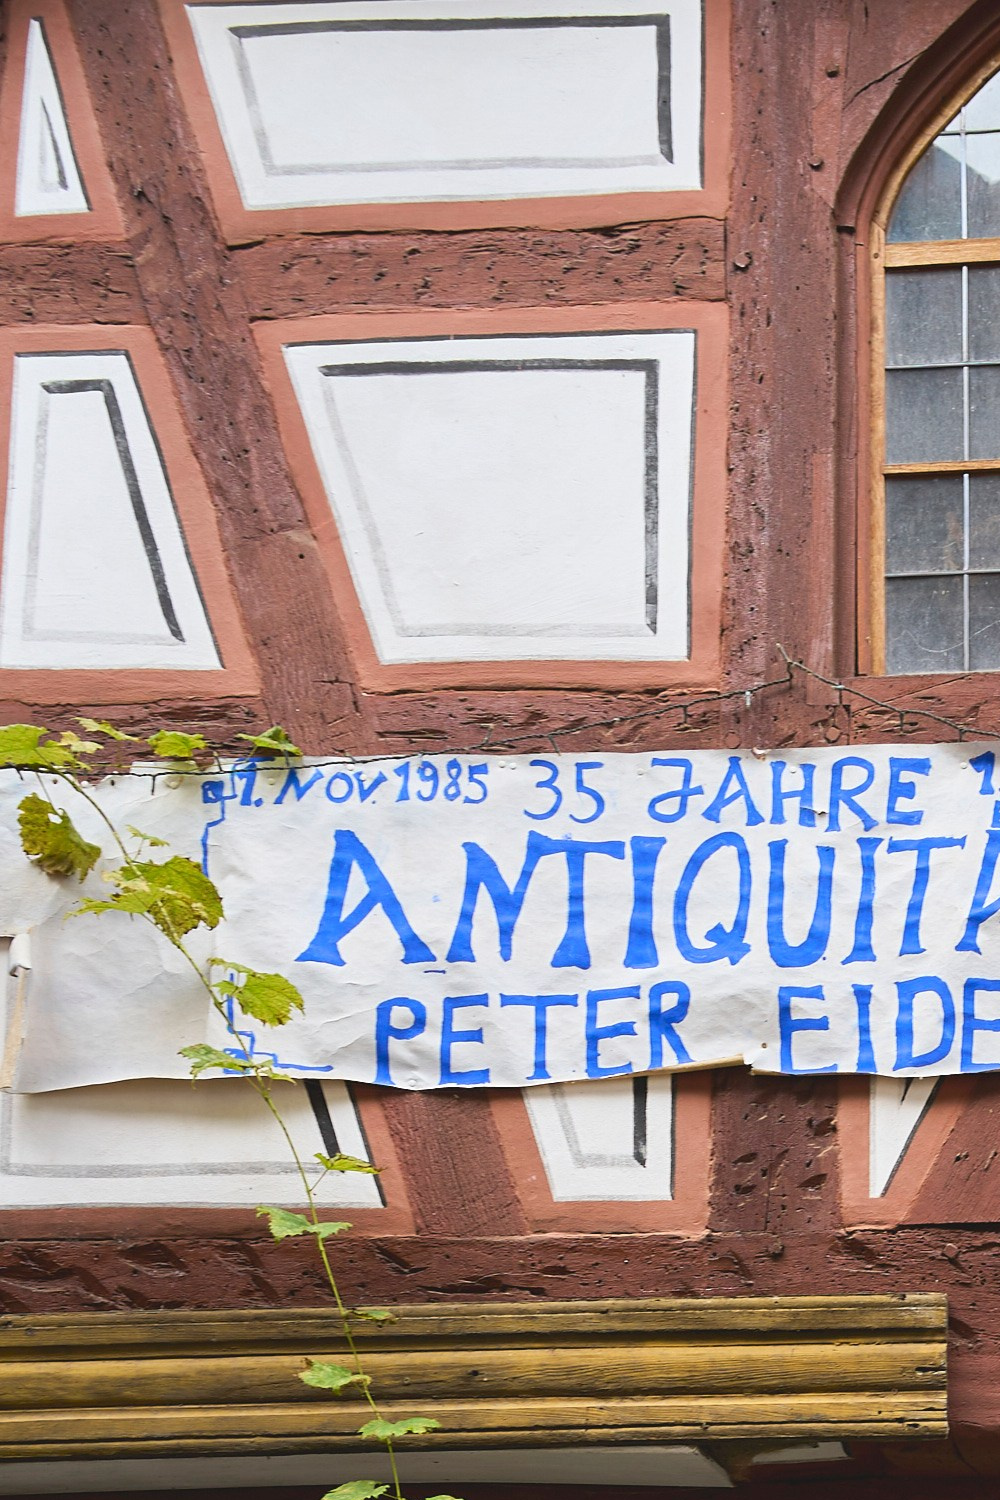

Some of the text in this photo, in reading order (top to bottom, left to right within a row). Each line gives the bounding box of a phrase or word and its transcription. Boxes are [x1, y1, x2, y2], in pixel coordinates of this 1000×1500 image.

[393, 757, 489, 804] 1985
[524, 758, 605, 824] 35
[647, 757, 932, 833] JAHRE
[374, 980, 693, 1085] PETER
